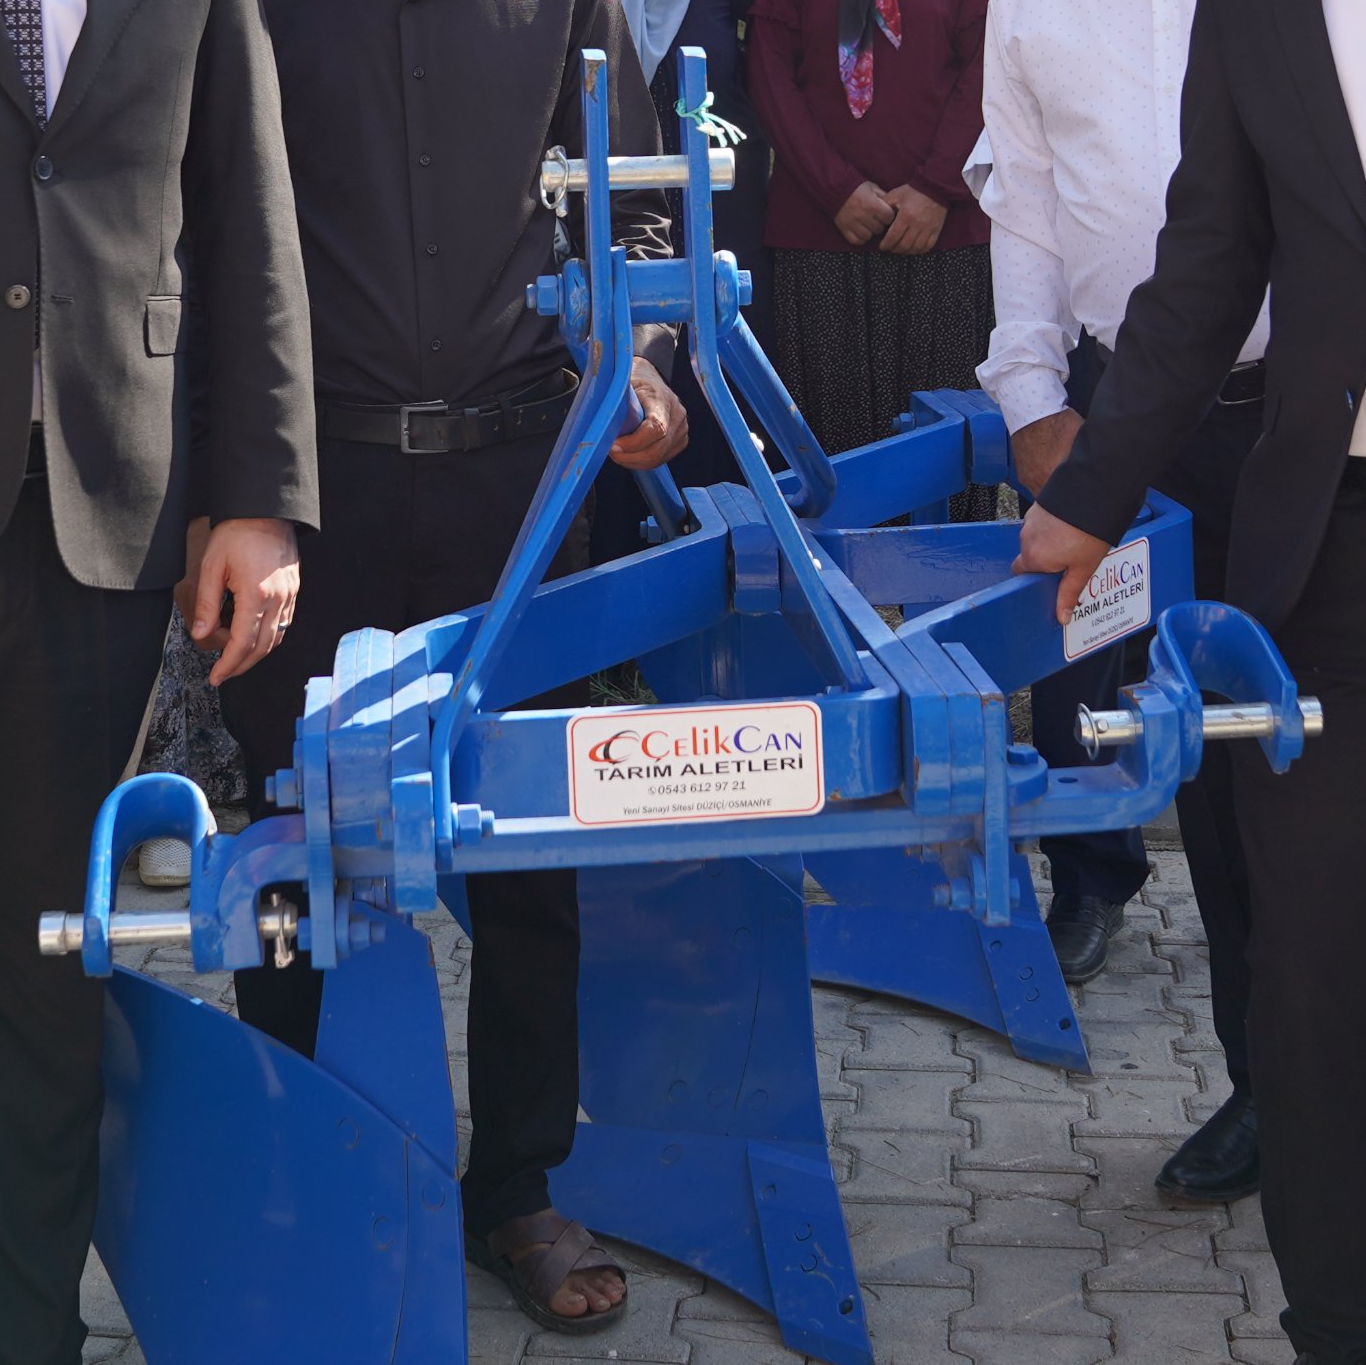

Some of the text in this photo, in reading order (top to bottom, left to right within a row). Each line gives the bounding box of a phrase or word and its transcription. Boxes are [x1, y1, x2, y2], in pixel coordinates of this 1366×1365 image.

[1073, 578, 1144, 622] TARIM ALETLERİ
[594, 753, 804, 782] TARIM ALETLERİ
[657, 780, 746, 795] 0543 612 97 21
[623, 798, 772, 816] Yeni Sanayi Sitesi DÜZİÇİ/OSMANİYE
